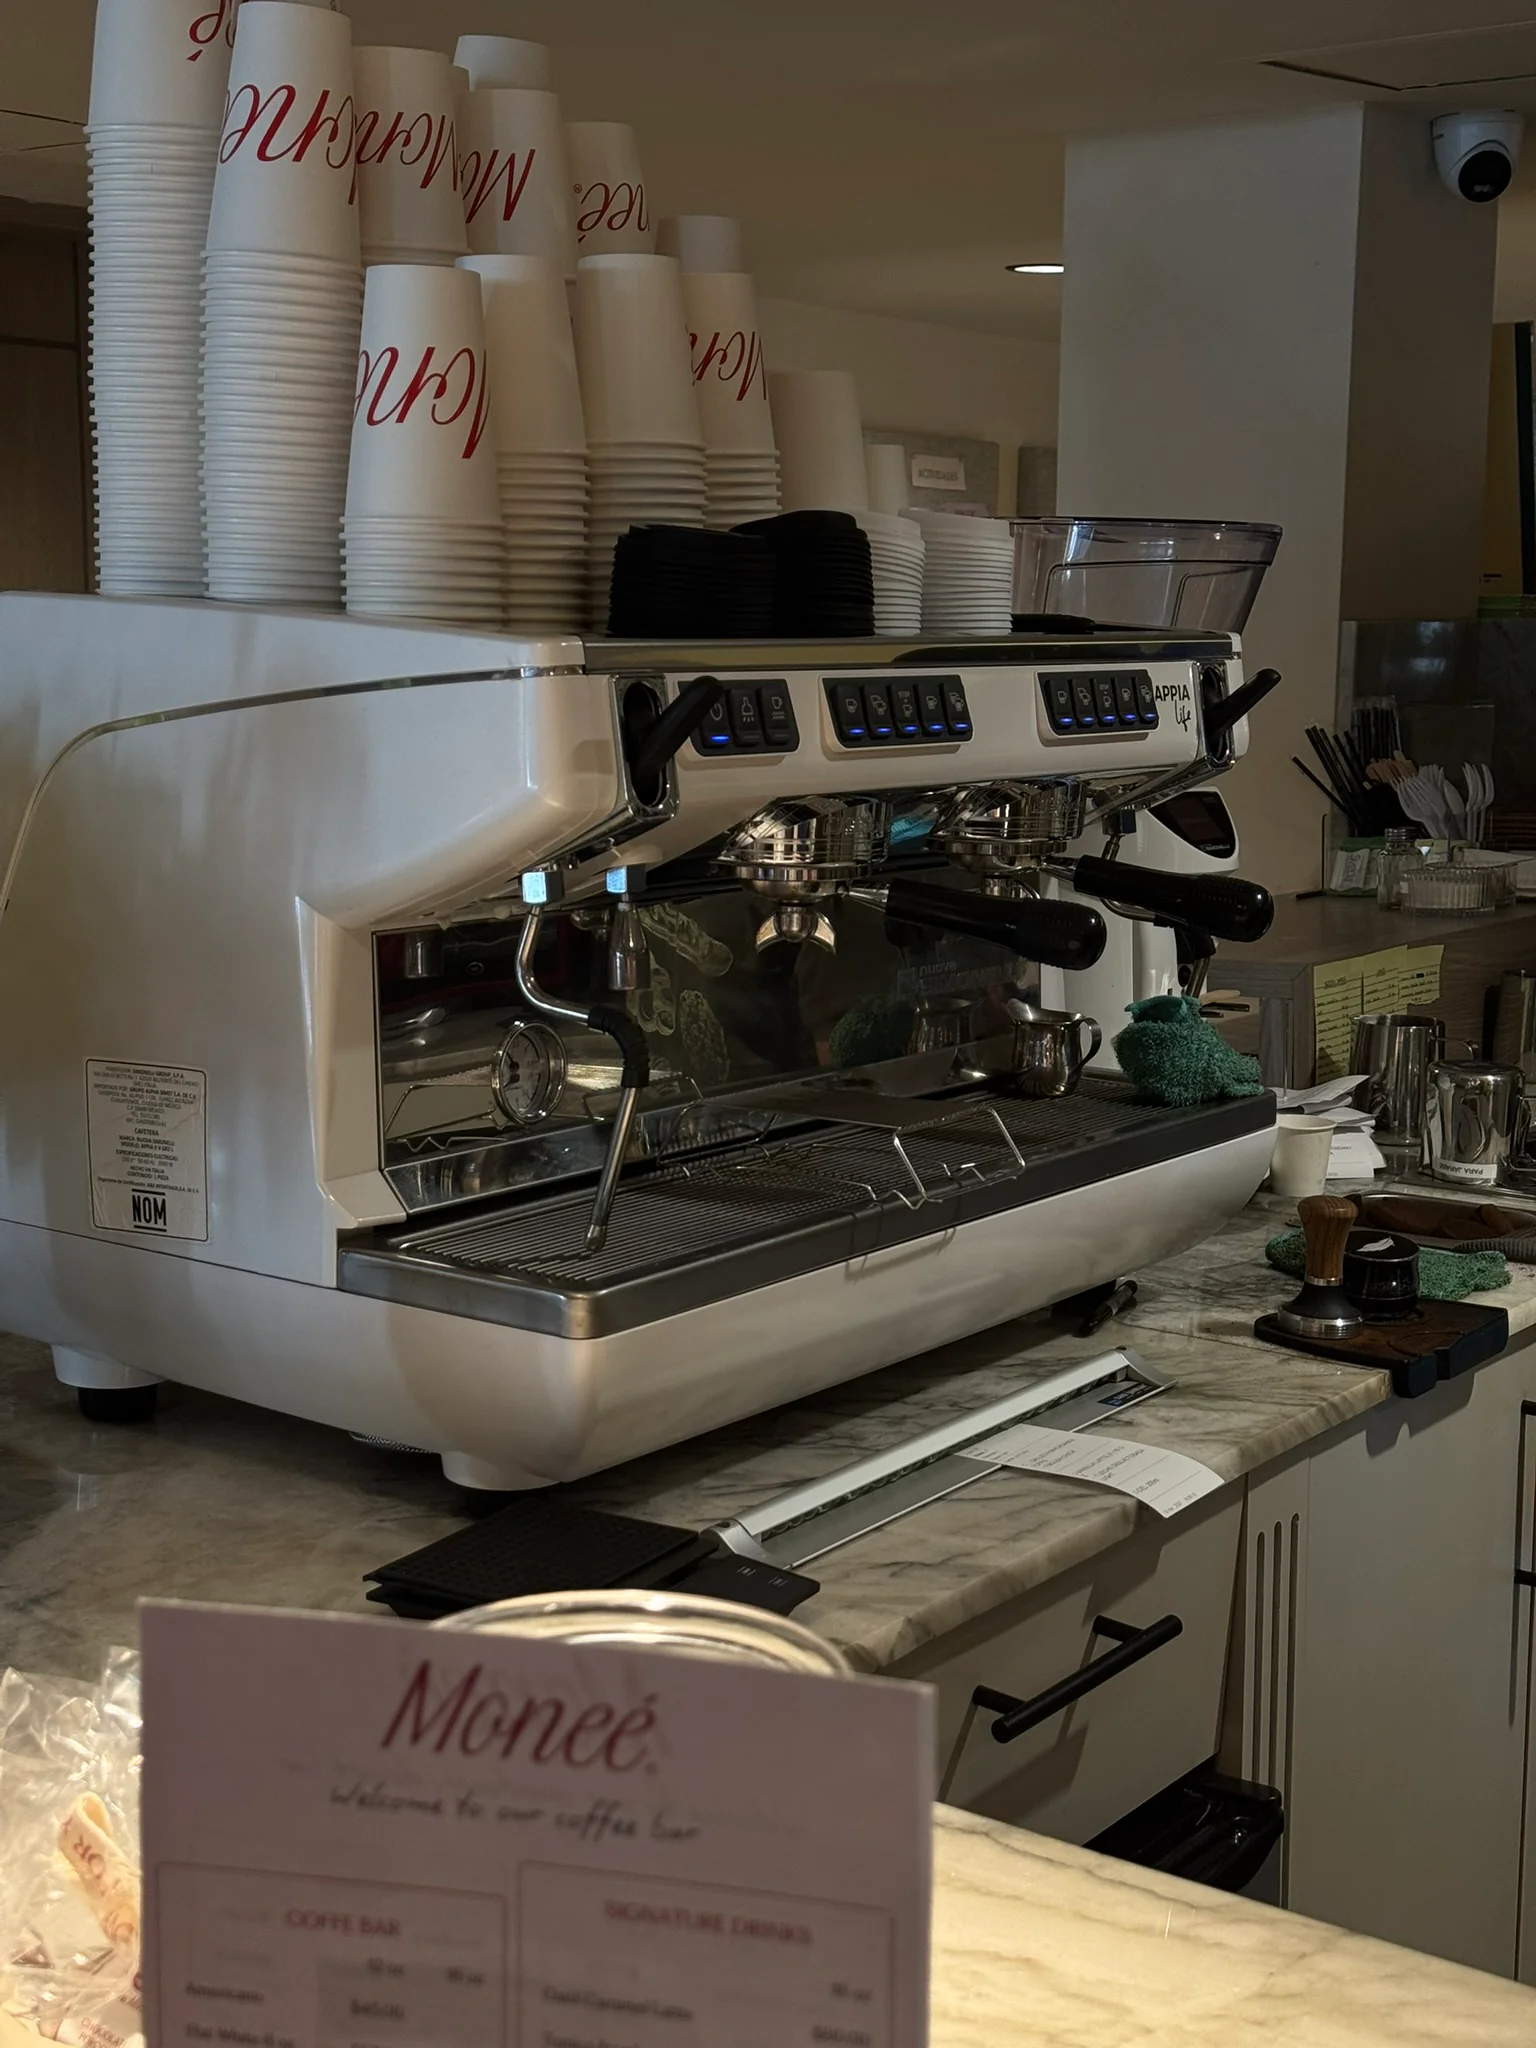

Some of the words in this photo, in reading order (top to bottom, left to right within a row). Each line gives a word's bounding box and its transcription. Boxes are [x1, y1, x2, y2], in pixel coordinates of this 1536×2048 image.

[1155, 685, 1190, 701] APPIA
[131, 1195, 167, 1226] NOM
[329, 1780, 444, 1821] Welcome
[455, 1791, 489, 1821] to
[497, 1804, 545, 1823] our
[554, 1798, 638, 1842] coffee
[650, 1812, 702, 1842] bar
[360, 1914, 401, 1937] BAR
[604, 1899, 725, 1934] SIGNATURE
[731, 1915, 813, 1947] DRINKS
